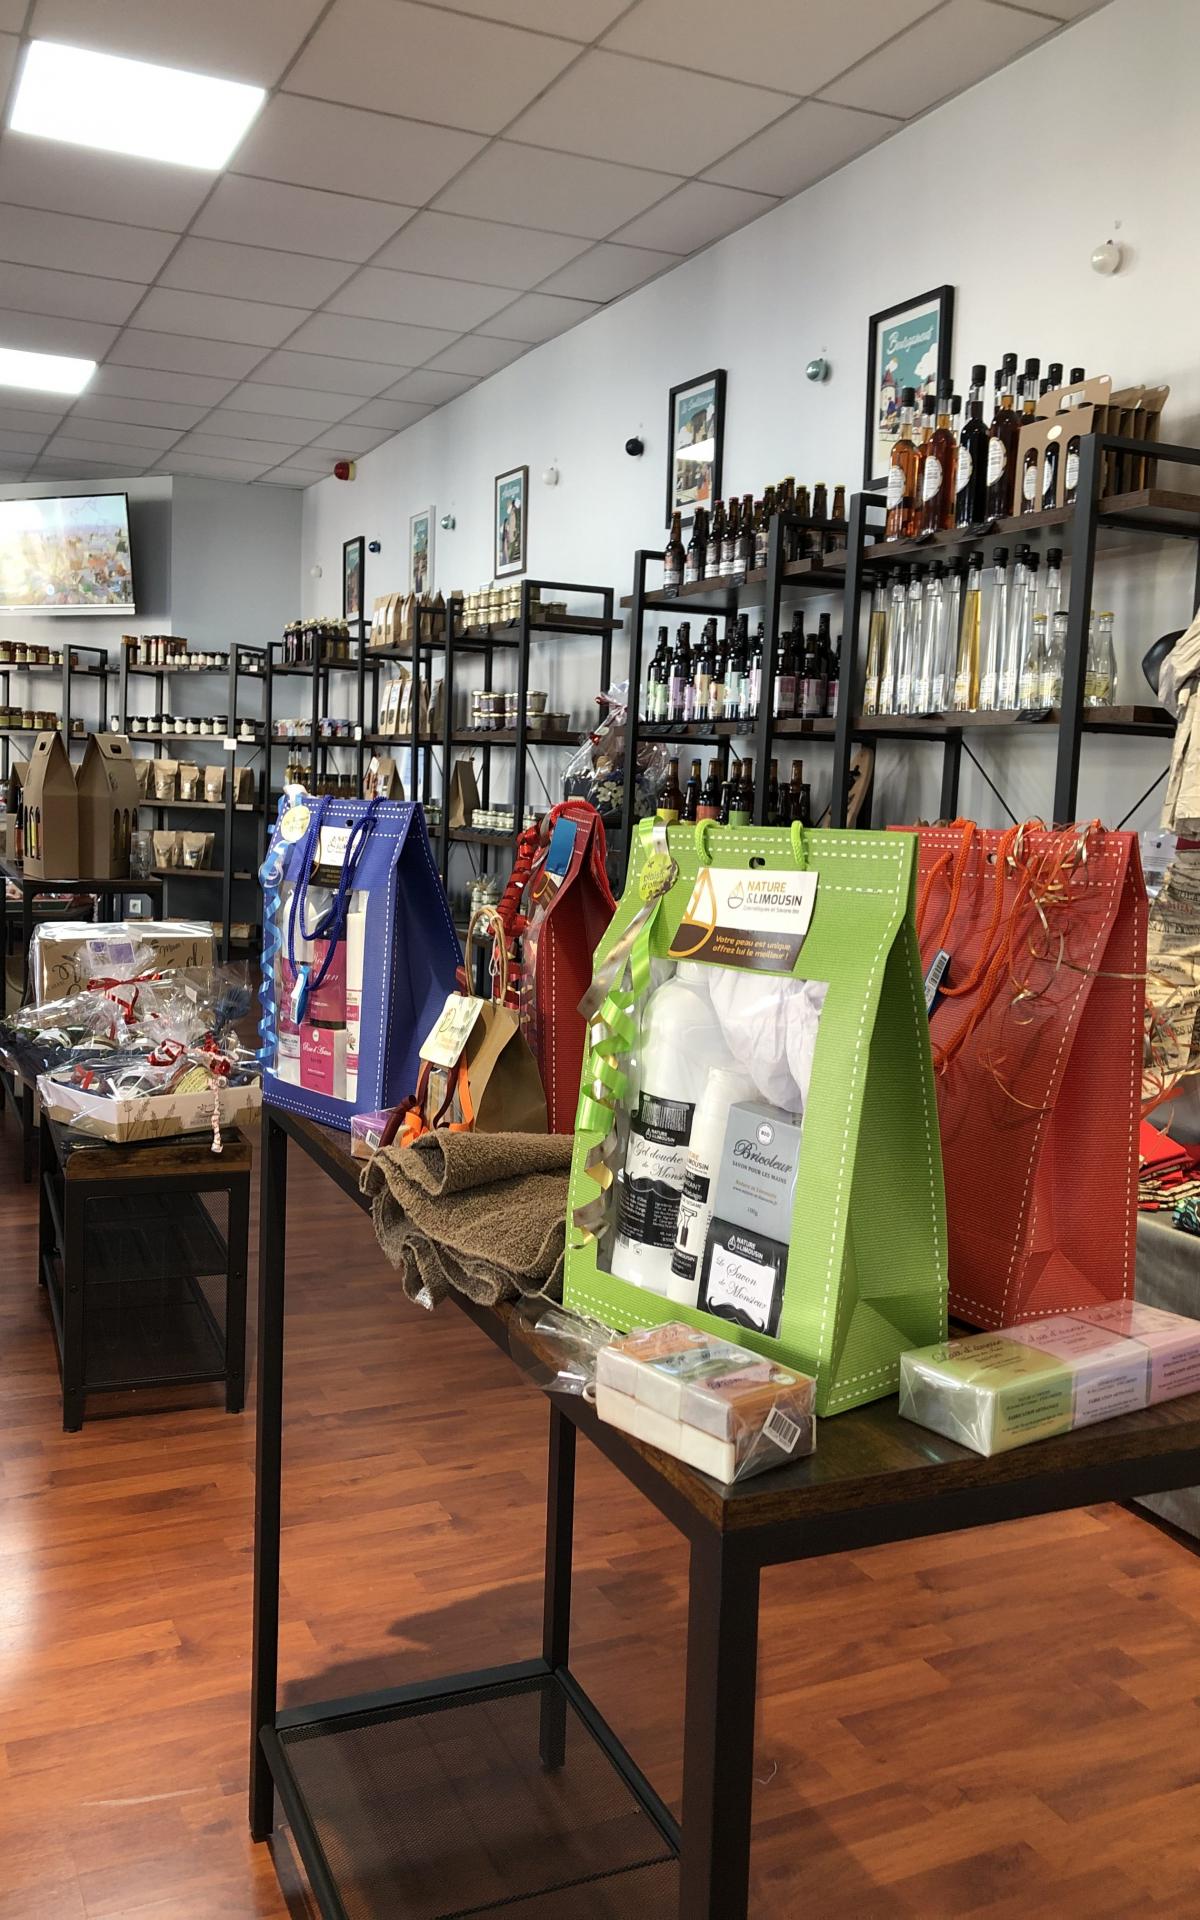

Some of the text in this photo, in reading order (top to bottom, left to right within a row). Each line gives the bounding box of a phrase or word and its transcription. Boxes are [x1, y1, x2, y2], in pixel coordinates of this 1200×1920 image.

[748, 880, 786, 893] NATURE
[746, 892, 803, 907] &LIMOUSIN
[716, 936, 734, 945] Votre
[735, 939, 754, 948] peau
[754, 940, 766, 948] est
[712, 945, 734, 954] offrez
[746, 948, 752, 956] le
[754, 949, 784, 960] meilleur
[634, 1140, 683, 1164] Gel douche
[734, 1140, 792, 1173] Bricoleur
[732, 1160, 748, 1170] SAVON
[748, 1166, 762, 1176] POUR
[771, 1174, 787, 1184] MAINS
[736, 1236, 756, 1248] NATURE
[716, 1257, 757, 1286] Le Savon
[726, 1282, 767, 1309] Monsieur
